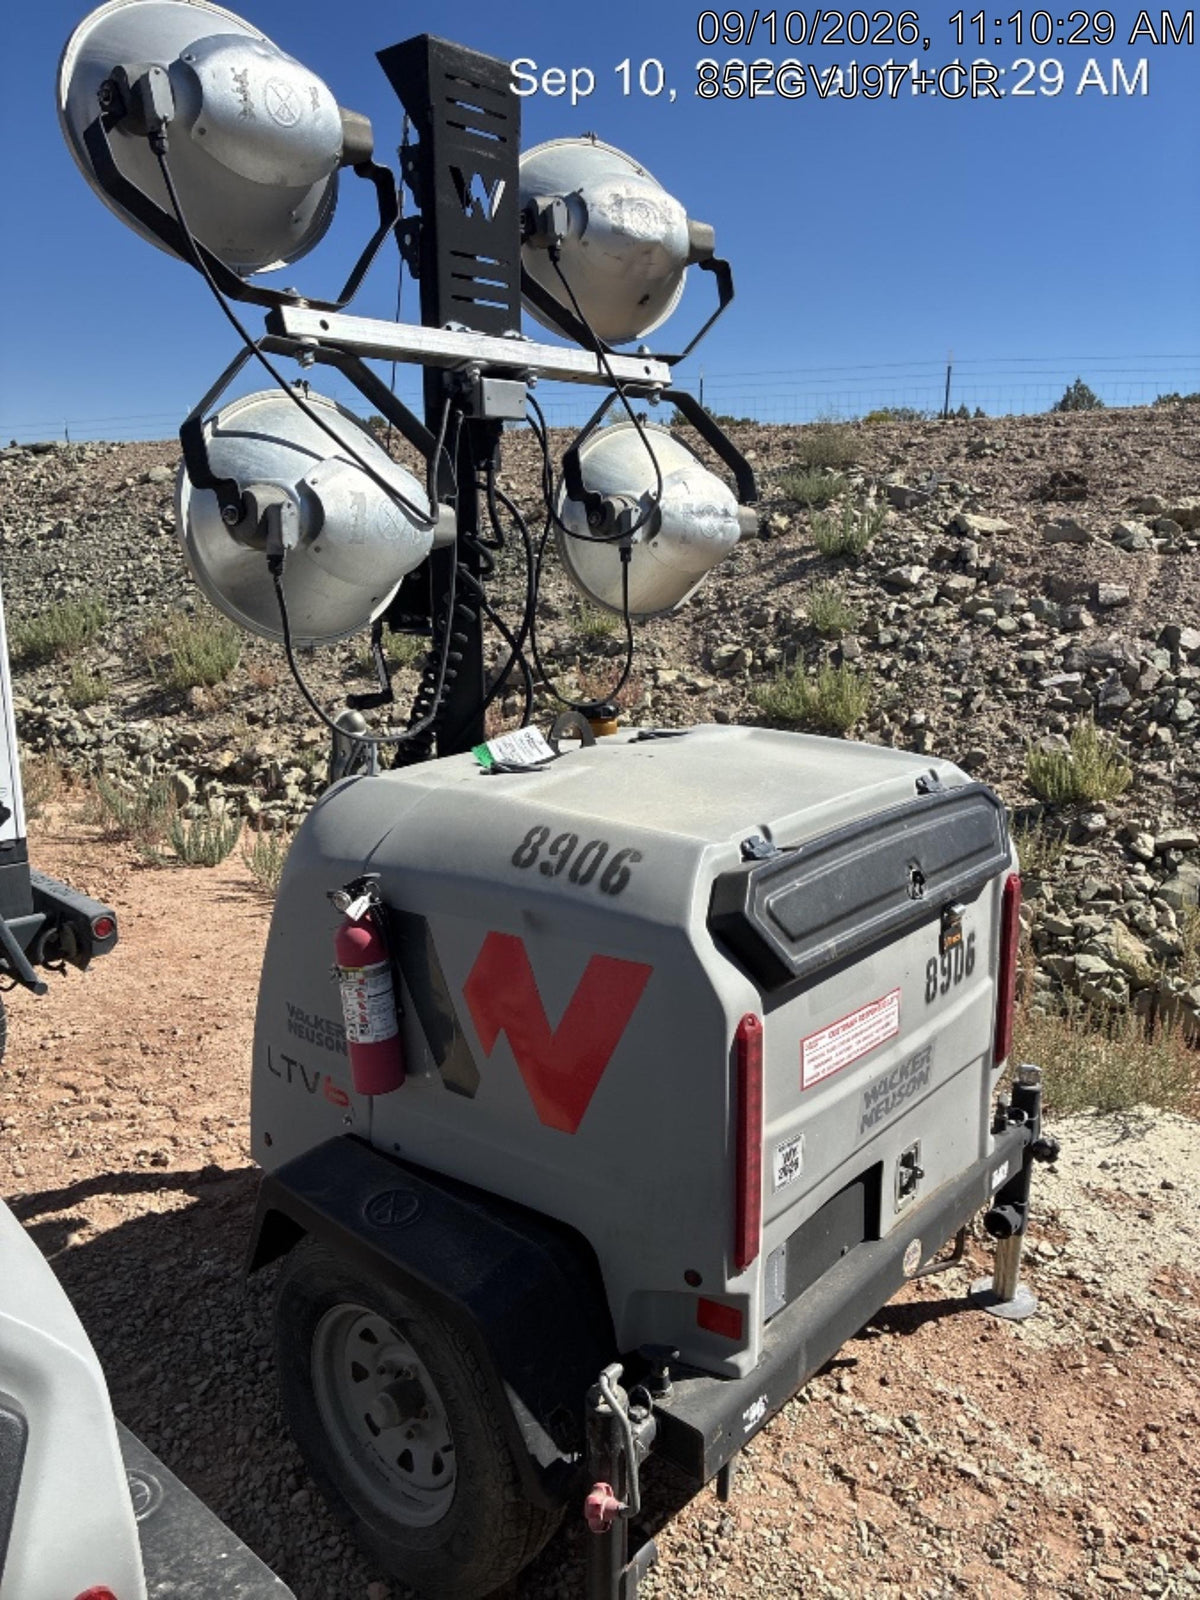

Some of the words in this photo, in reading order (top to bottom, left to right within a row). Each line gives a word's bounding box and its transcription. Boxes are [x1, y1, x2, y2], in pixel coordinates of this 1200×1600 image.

[511, 824, 643, 896] 8906
[925, 930, 975, 1004] 8906
[287, 1018, 348, 1057] NEUSON
[267, 1045, 350, 1108] LTV6
[860, 1066, 931, 1135] NEUSON
[863, 1044, 933, 1110] WACKER
